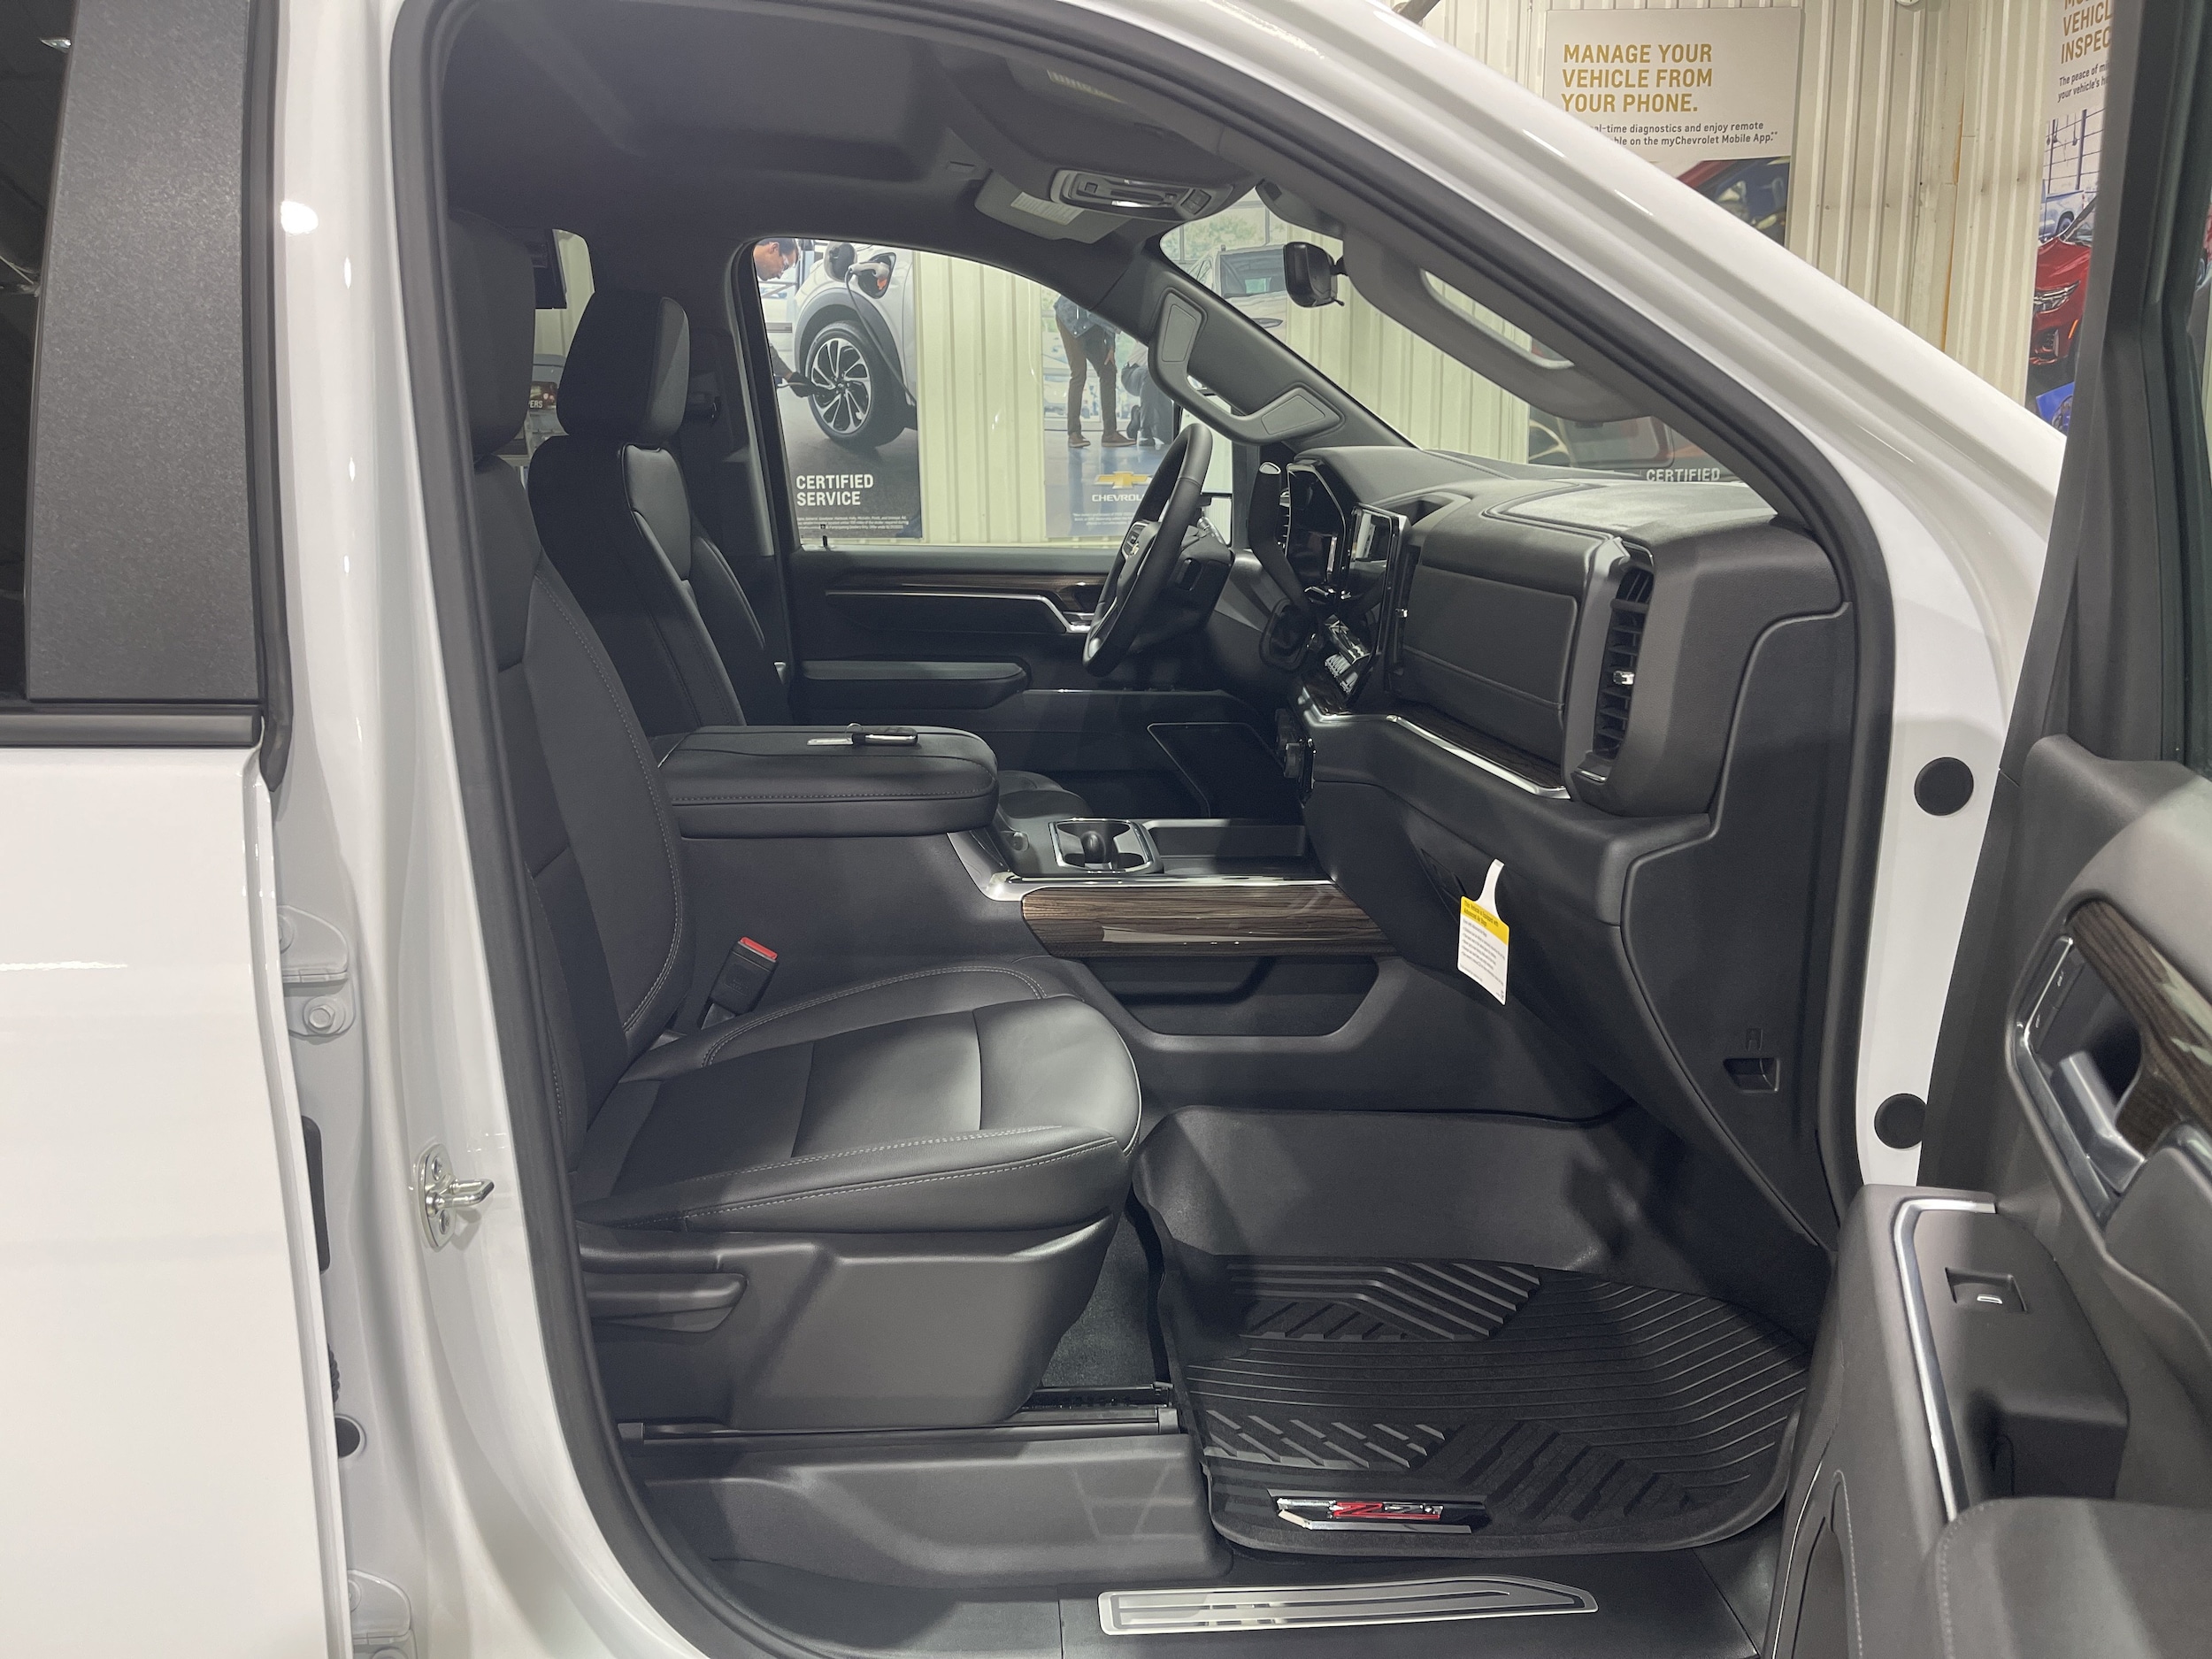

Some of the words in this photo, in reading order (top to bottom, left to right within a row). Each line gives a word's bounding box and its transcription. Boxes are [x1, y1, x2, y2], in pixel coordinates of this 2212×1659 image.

[2063, 0, 2113, 36] VEHICL
[1563, 44, 1651, 64] MANAGE
[1658, 43, 1712, 63] YOUR
[1562, 69, 1648, 88] VEHICLE
[1655, 68, 1713, 87] FROM
[2059, 76, 2070, 87] The
[2071, 69, 2089, 85] peace
[2091, 64, 2099, 75] of
[1561, 93, 1616, 112] YOUR
[1623, 93, 1698, 112] PHONE.
[2057, 88, 2072, 103] your
[1630, 124, 1682, 134] diagnostics
[1685, 123, 1701, 133] and
[1703, 123, 1729, 134] enjoy
[1731, 121, 1763, 131] remote
[1644, 136, 1659, 145] the
[1661, 134, 1719, 147] myChevrolet
[1722, 134, 1751, 143] Mobile
[796, 474, 874, 489] CERTIFIED
[1647, 467, 1720, 482] CERTIFIED
[796, 491, 861, 506] SERVICE
